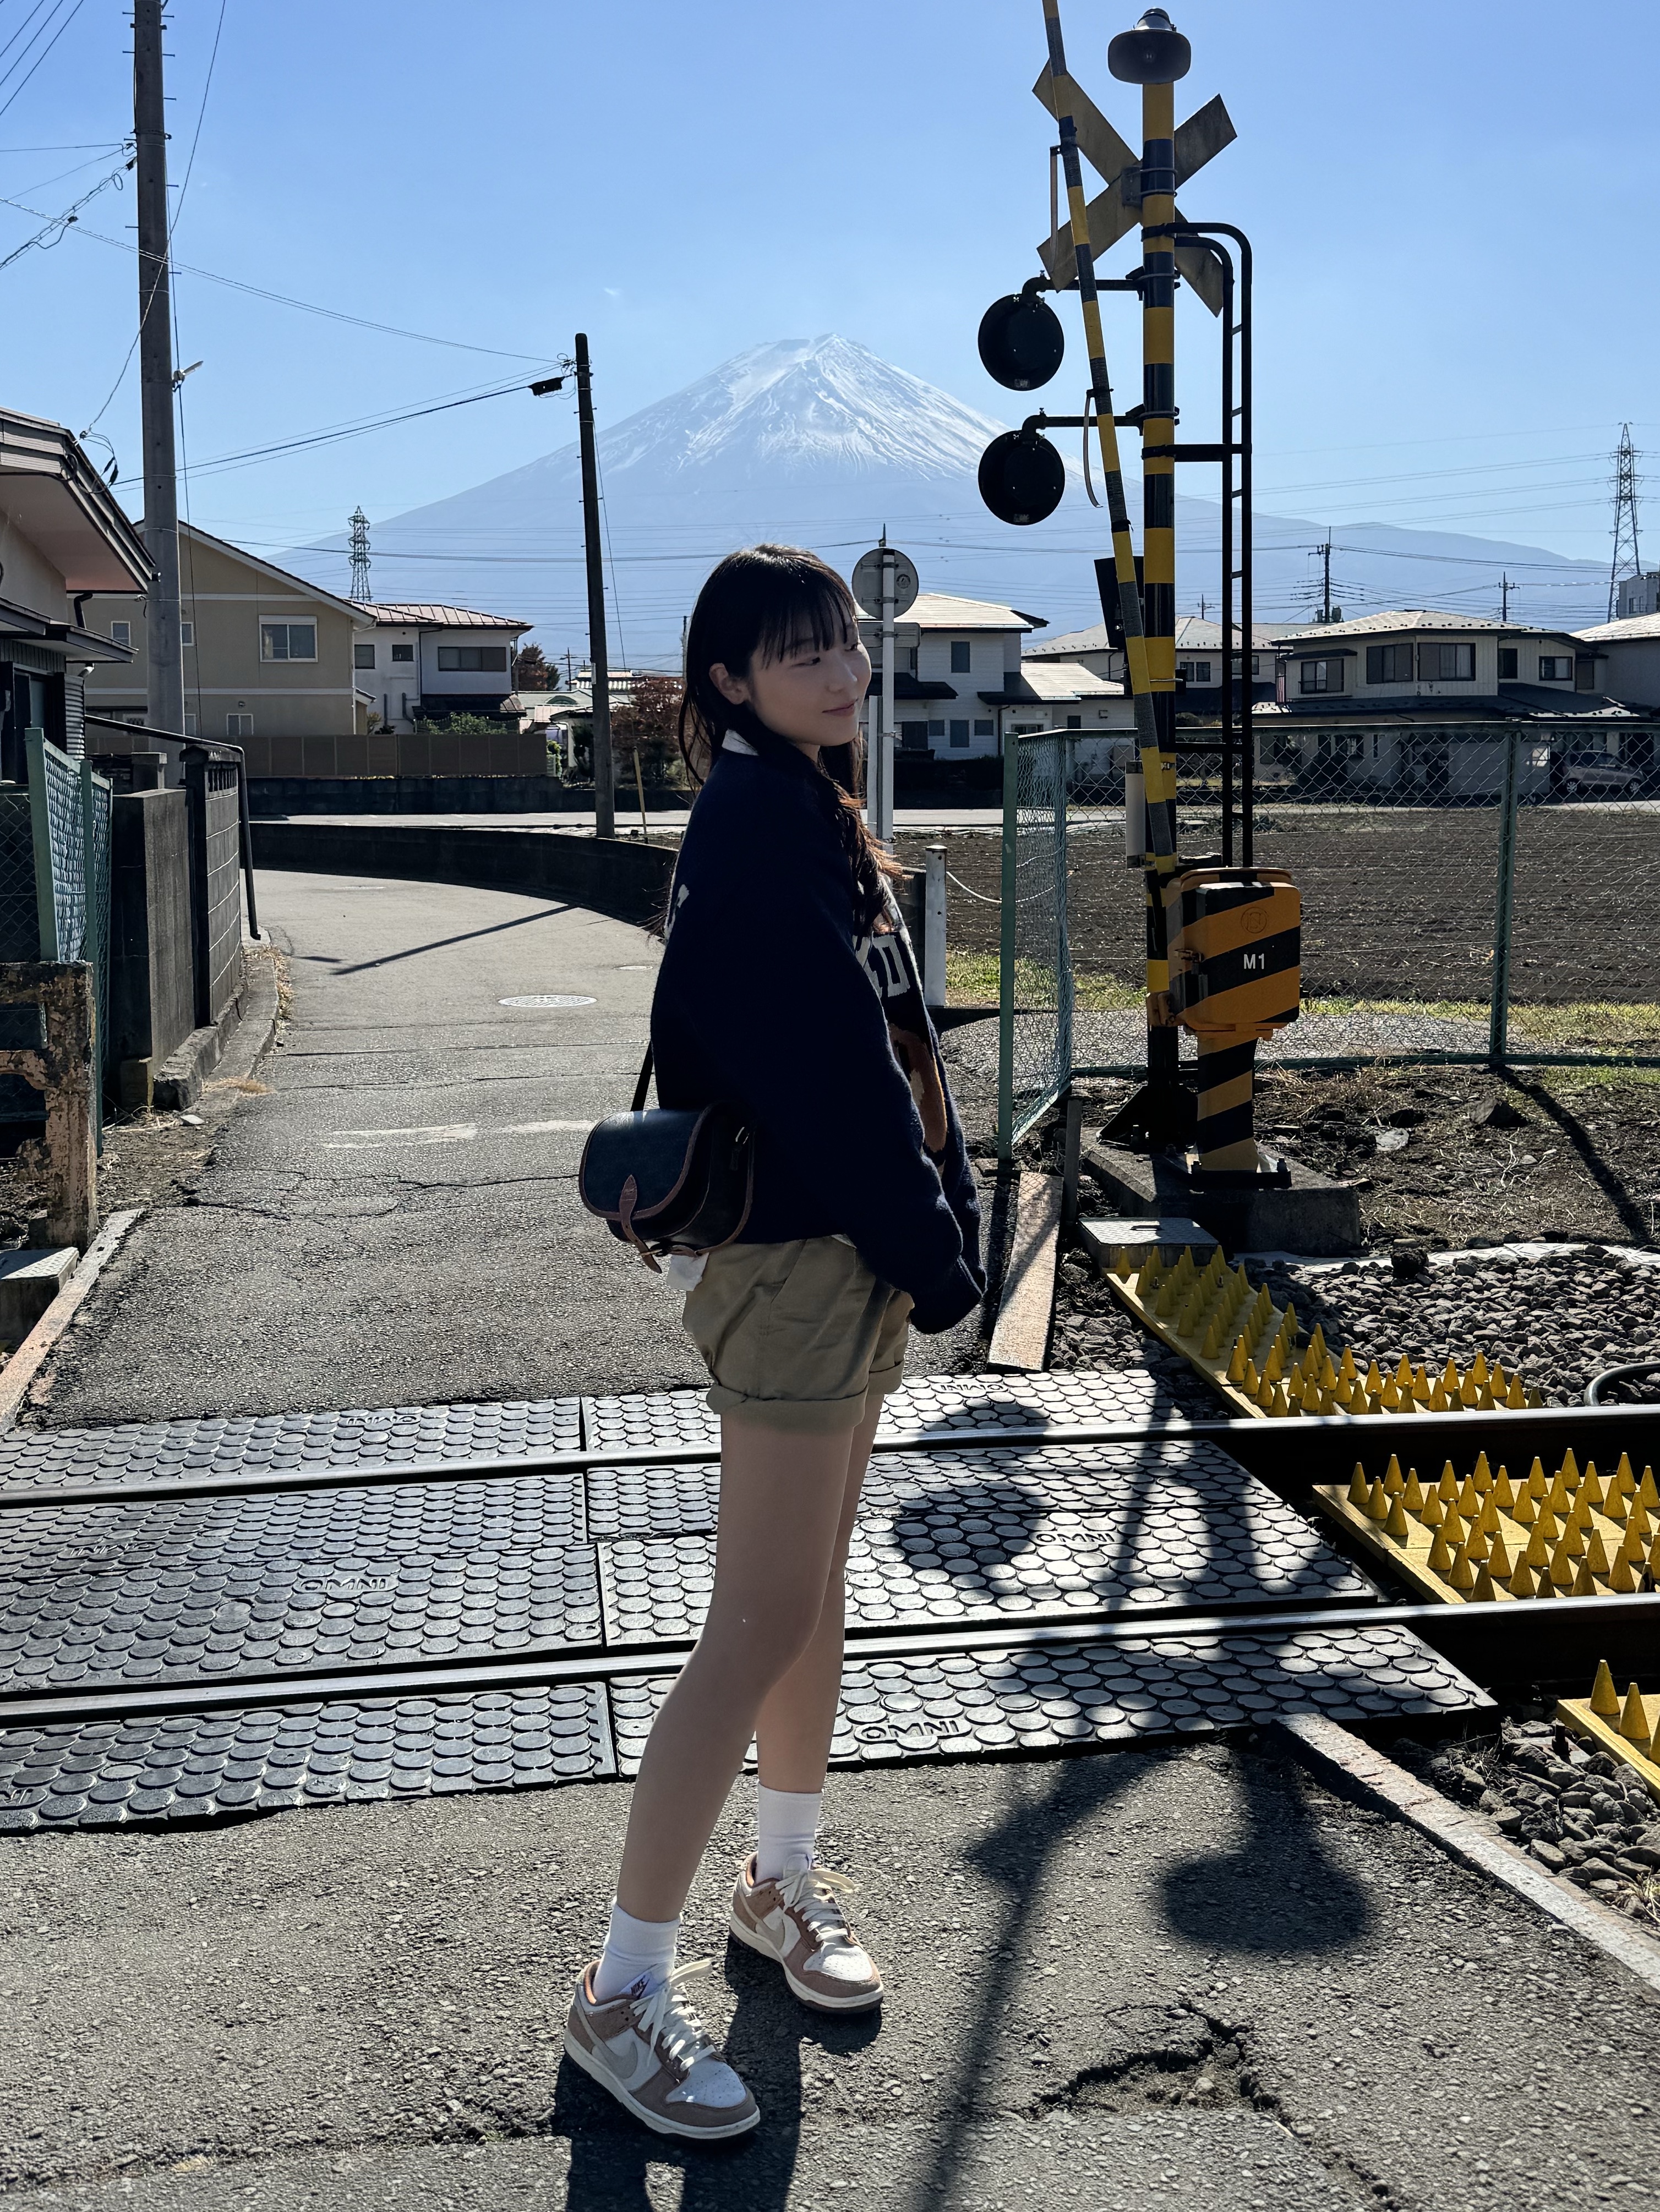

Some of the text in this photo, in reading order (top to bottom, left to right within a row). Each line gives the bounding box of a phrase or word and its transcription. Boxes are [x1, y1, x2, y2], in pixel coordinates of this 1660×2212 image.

[1244, 953, 1264, 970] M1
[1036, 1533, 1115, 1542] OMNI
[301, 1578, 386, 1590] OMNI
[861, 1720, 959, 1739] OMNI
